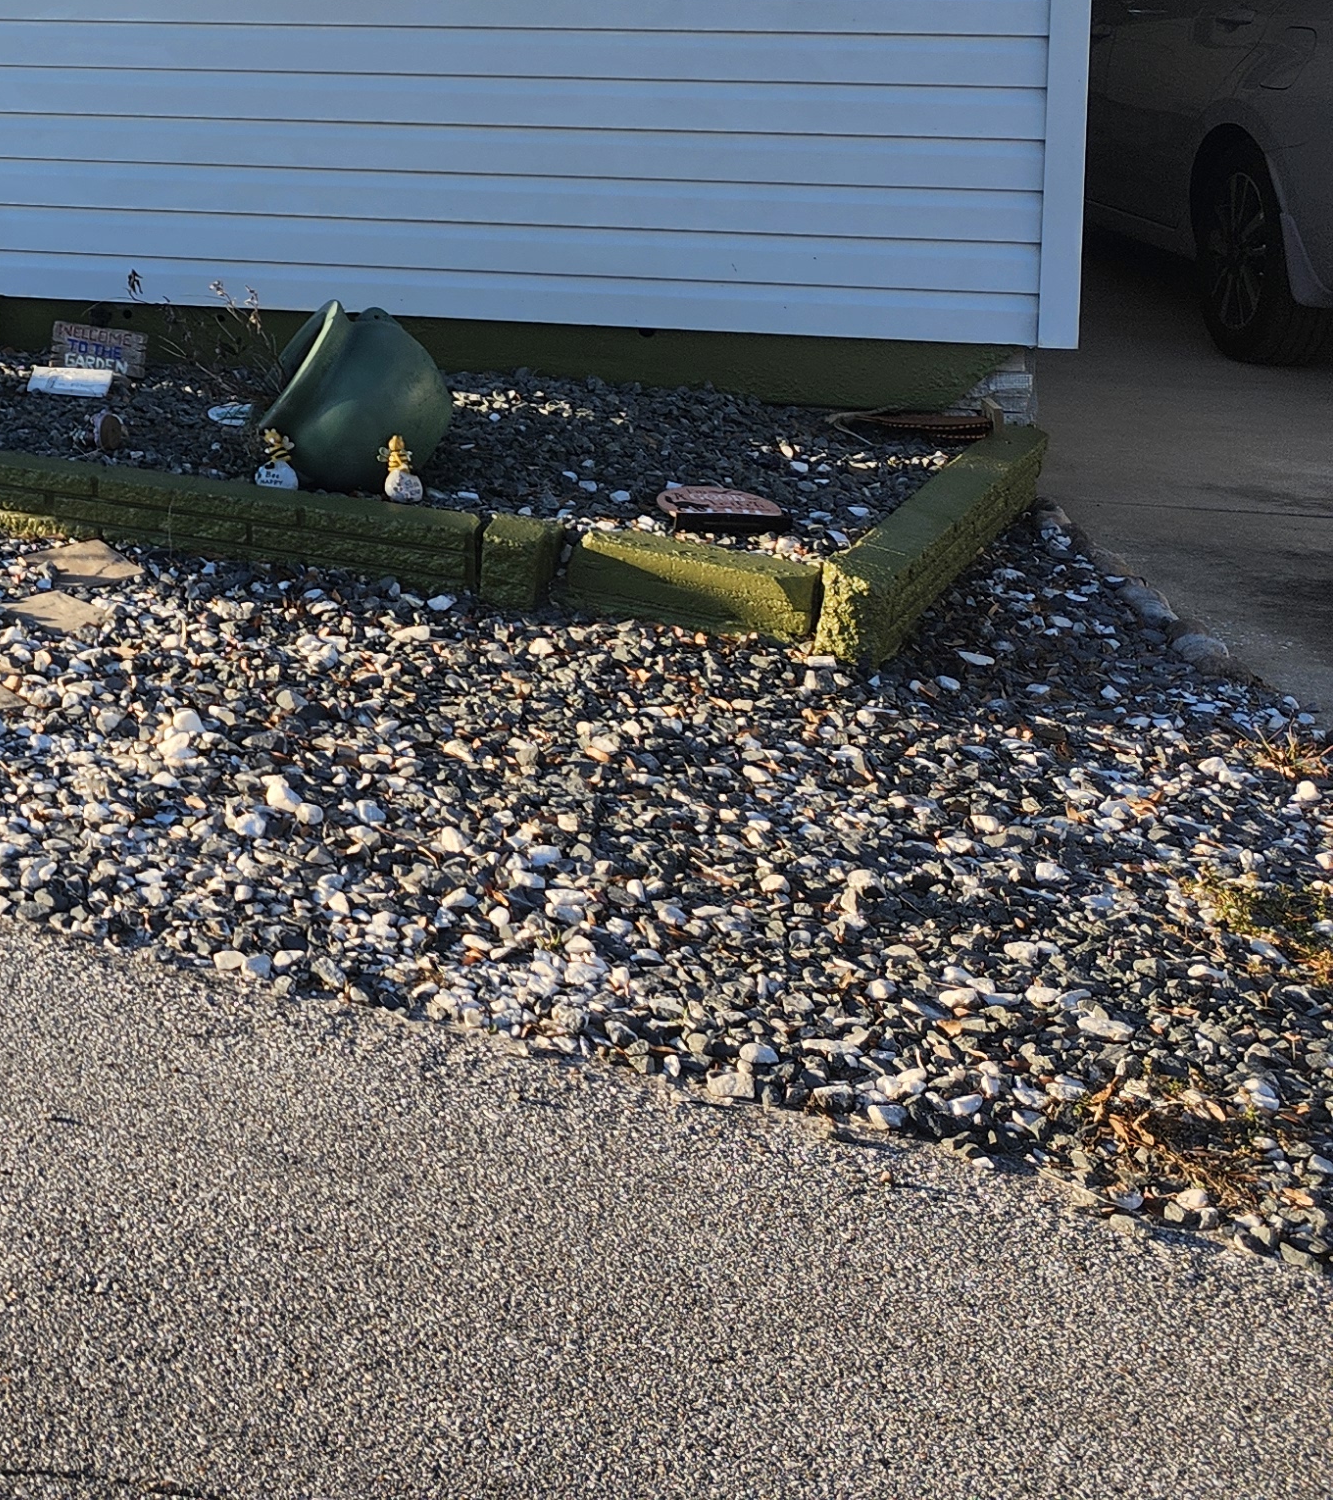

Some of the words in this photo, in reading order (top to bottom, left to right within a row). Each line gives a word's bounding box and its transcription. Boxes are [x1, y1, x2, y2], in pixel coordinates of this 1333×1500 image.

[58, 323, 132, 348] WELCOME
[67, 338, 88, 354] TO
[92, 342, 122, 360] THE
[64, 352, 129, 375] GARDEN
